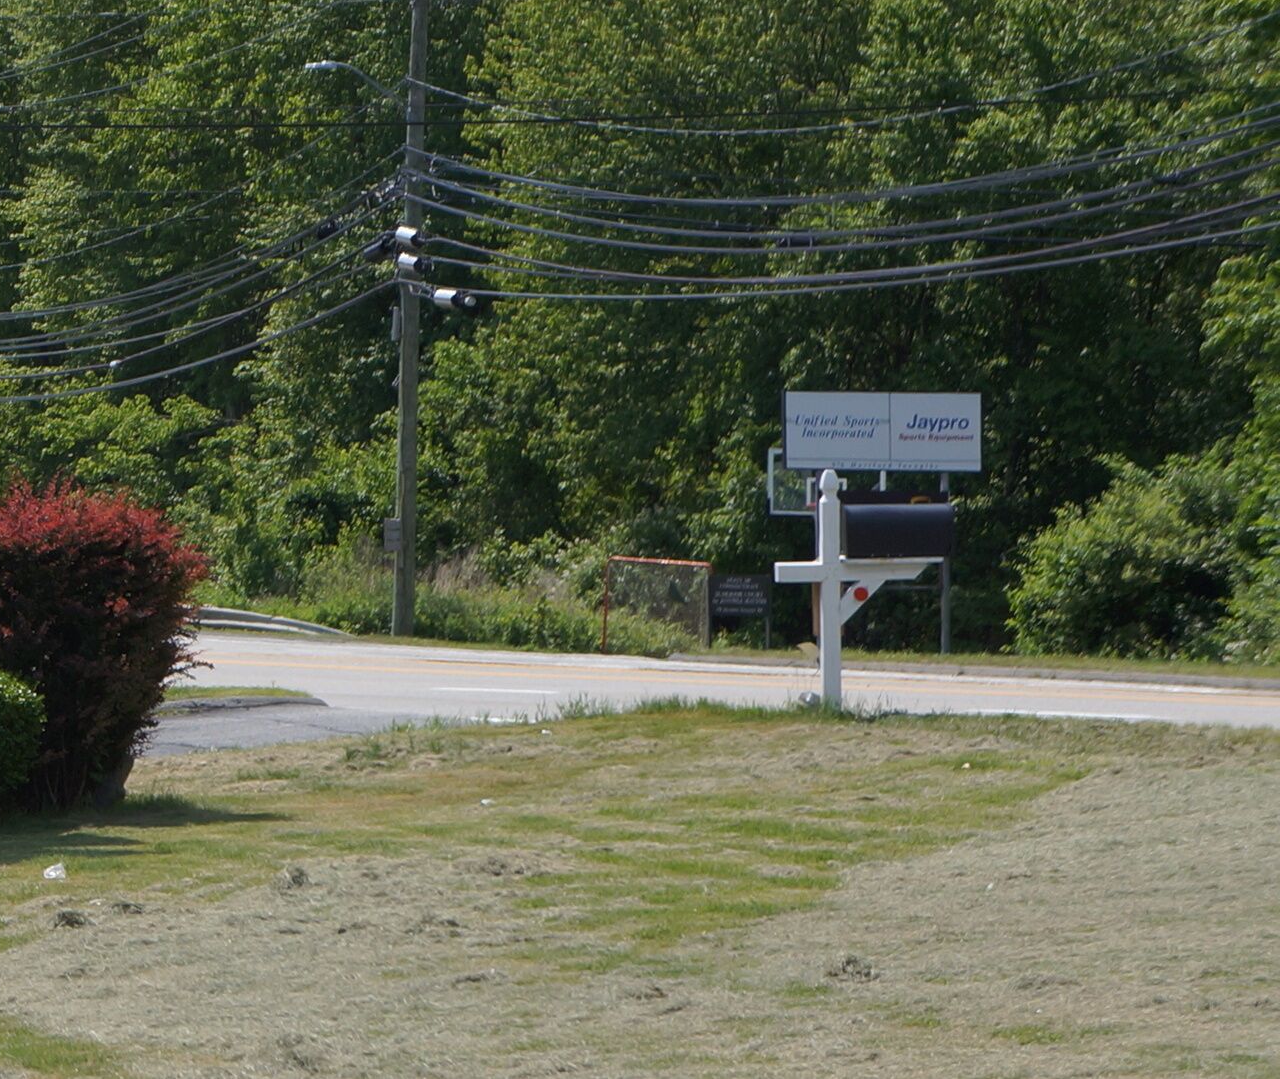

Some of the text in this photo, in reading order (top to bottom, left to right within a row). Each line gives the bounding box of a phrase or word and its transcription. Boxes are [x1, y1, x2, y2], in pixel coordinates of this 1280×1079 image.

[795, 414, 881, 429] Unified Sports
[906, 413, 970, 433] Jaypro
[801, 426, 875, 439] Incorporated
